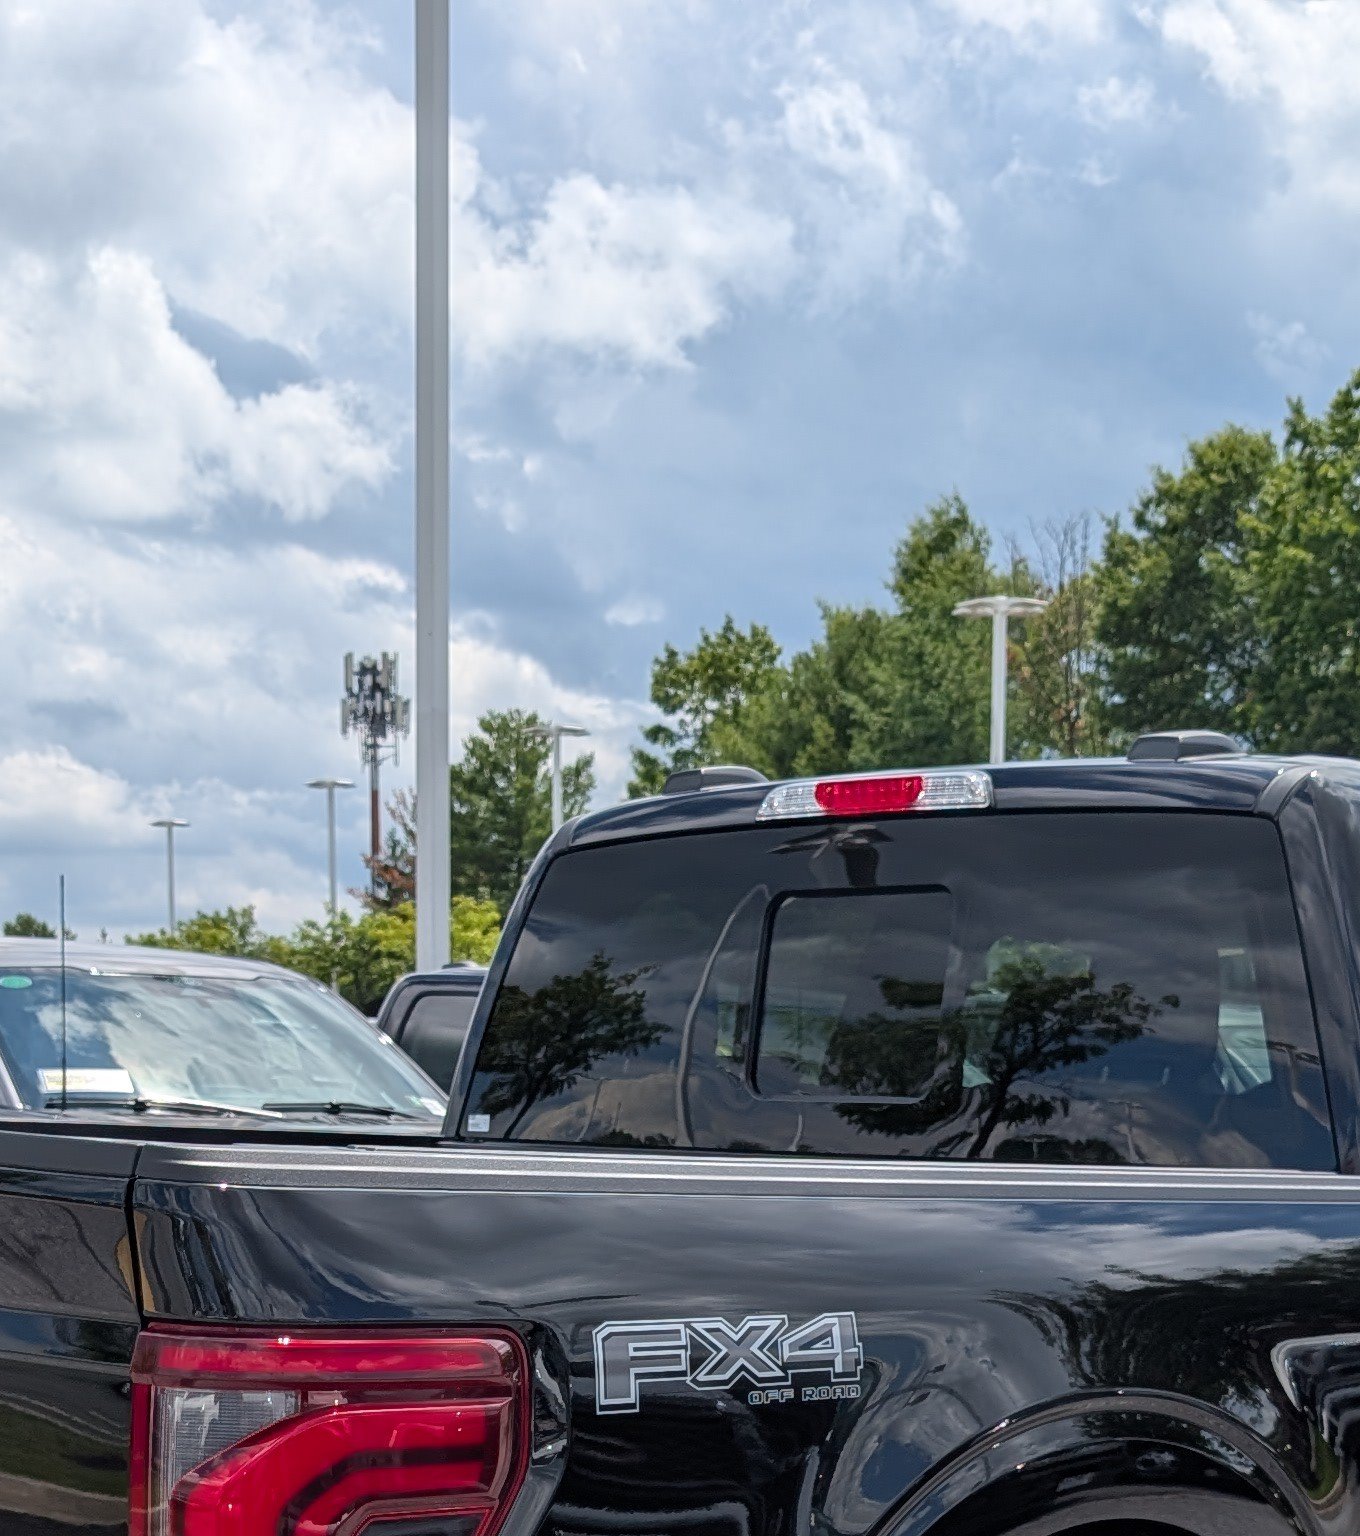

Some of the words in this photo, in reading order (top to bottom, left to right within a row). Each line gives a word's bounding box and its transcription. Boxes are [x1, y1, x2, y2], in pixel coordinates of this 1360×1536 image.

[592, 1311, 863, 1416] FX4
[748, 1390, 794, 1405] OFF
[801, 1384, 861, 1402] ROAD
